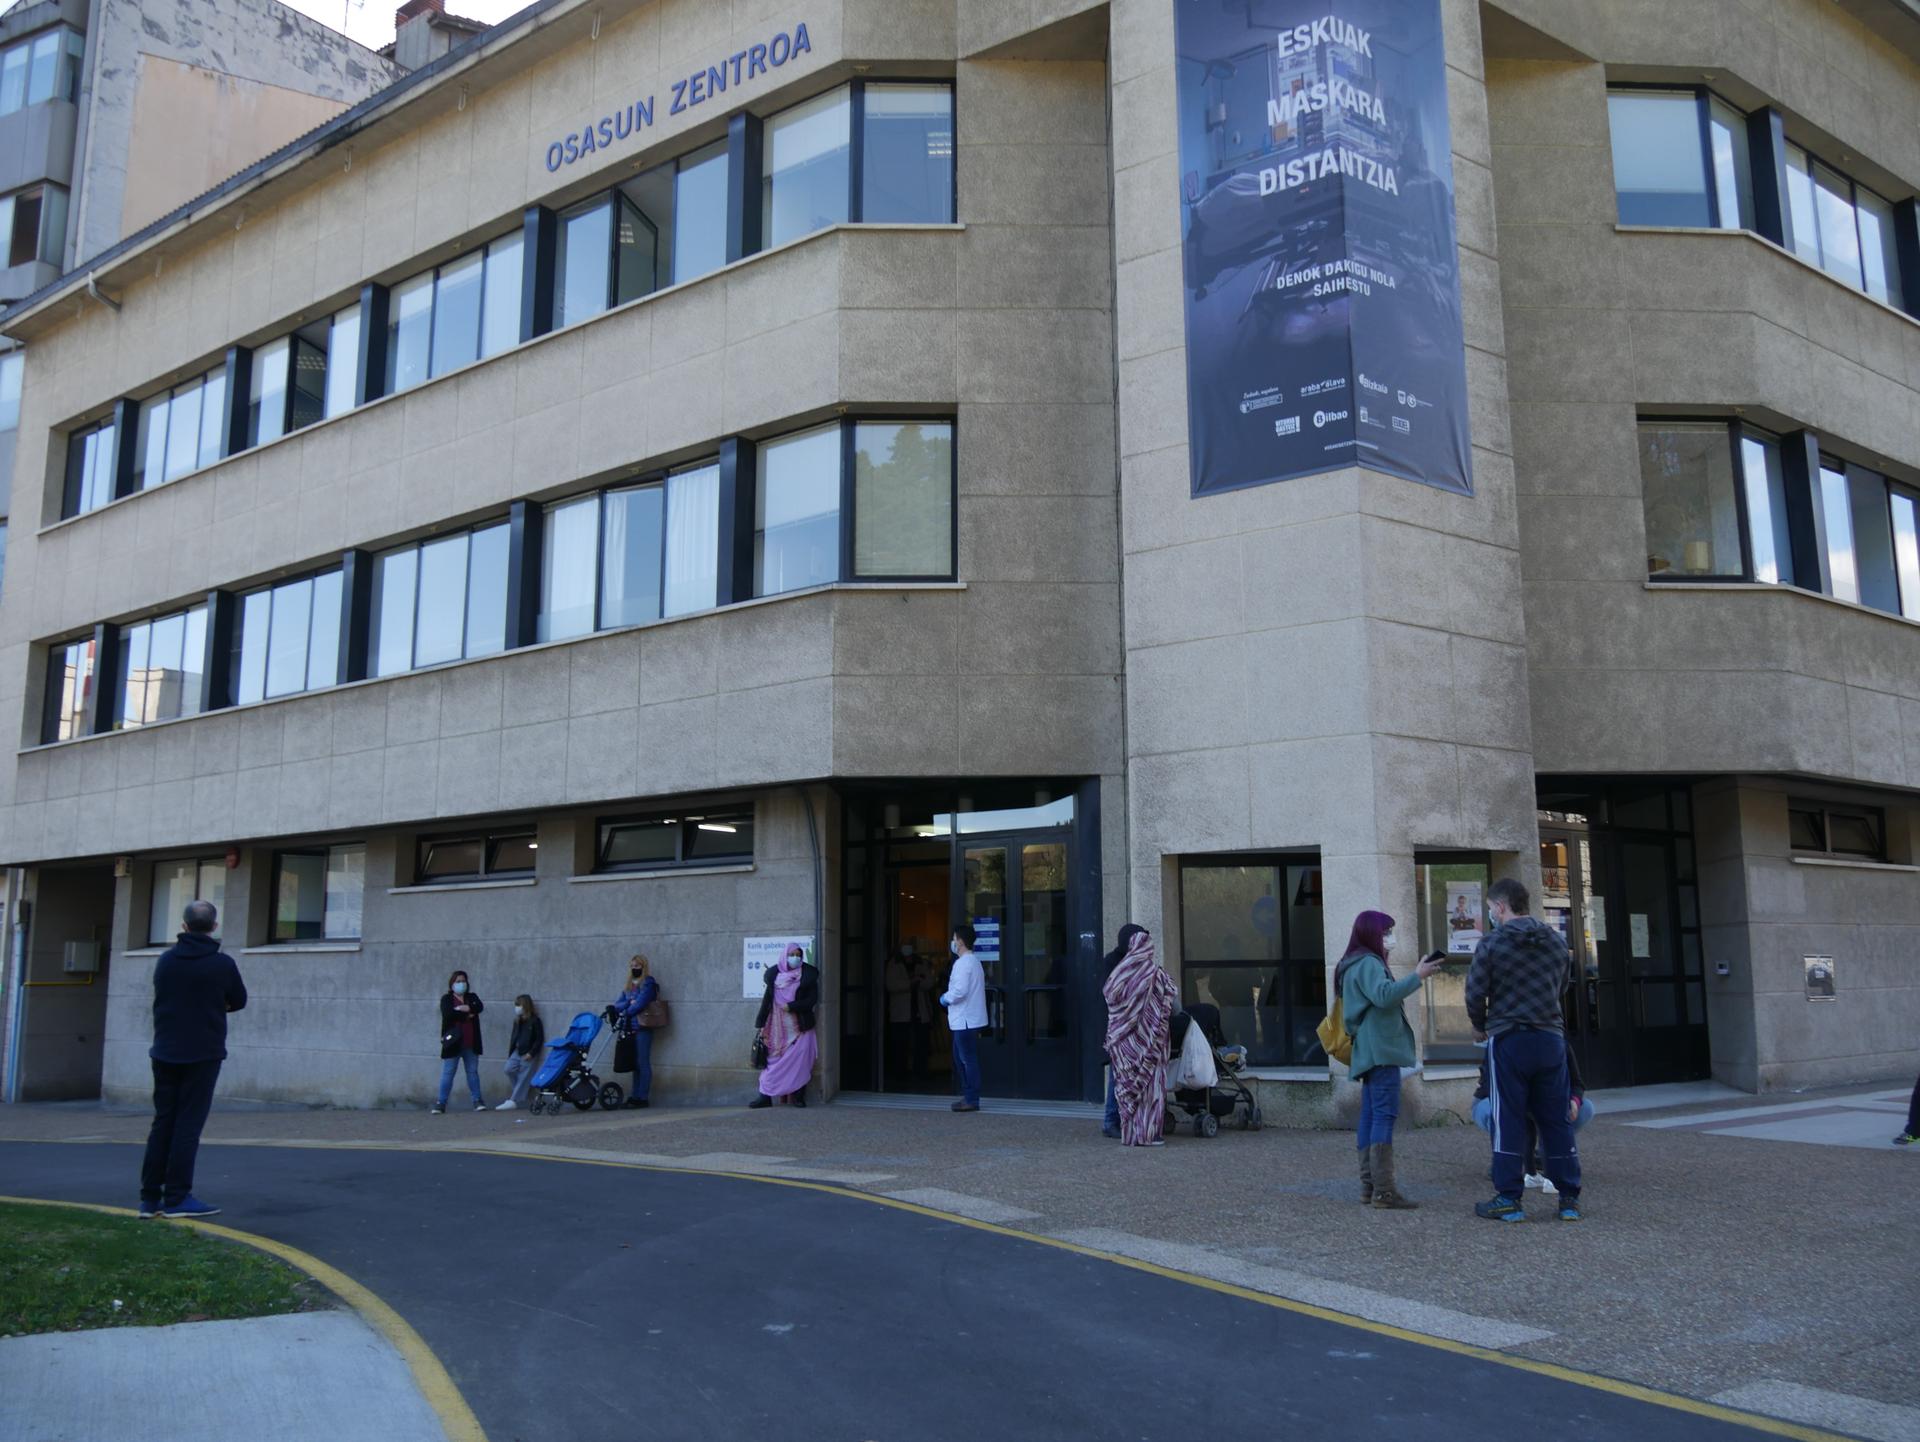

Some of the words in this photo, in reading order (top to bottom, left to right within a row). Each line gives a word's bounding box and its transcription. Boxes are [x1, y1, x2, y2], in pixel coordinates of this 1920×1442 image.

[1278, 15, 1372, 59] ESKUAK
[545, 96, 654, 173] OSASUN
[669, 22, 811, 116] ZENTROA
[1267, 79, 1387, 127] MASKARA
[1258, 146, 1399, 197] DISTANTZIA
[1276, 266, 1321, 290] DENOK
[1325, 259, 1367, 278] DAKIGU
[1370, 268, 1395, 289] NOLA
[1313, 276, 1371, 297] SAIHESTU
[1313, 410, 1348, 428] Bilbao
